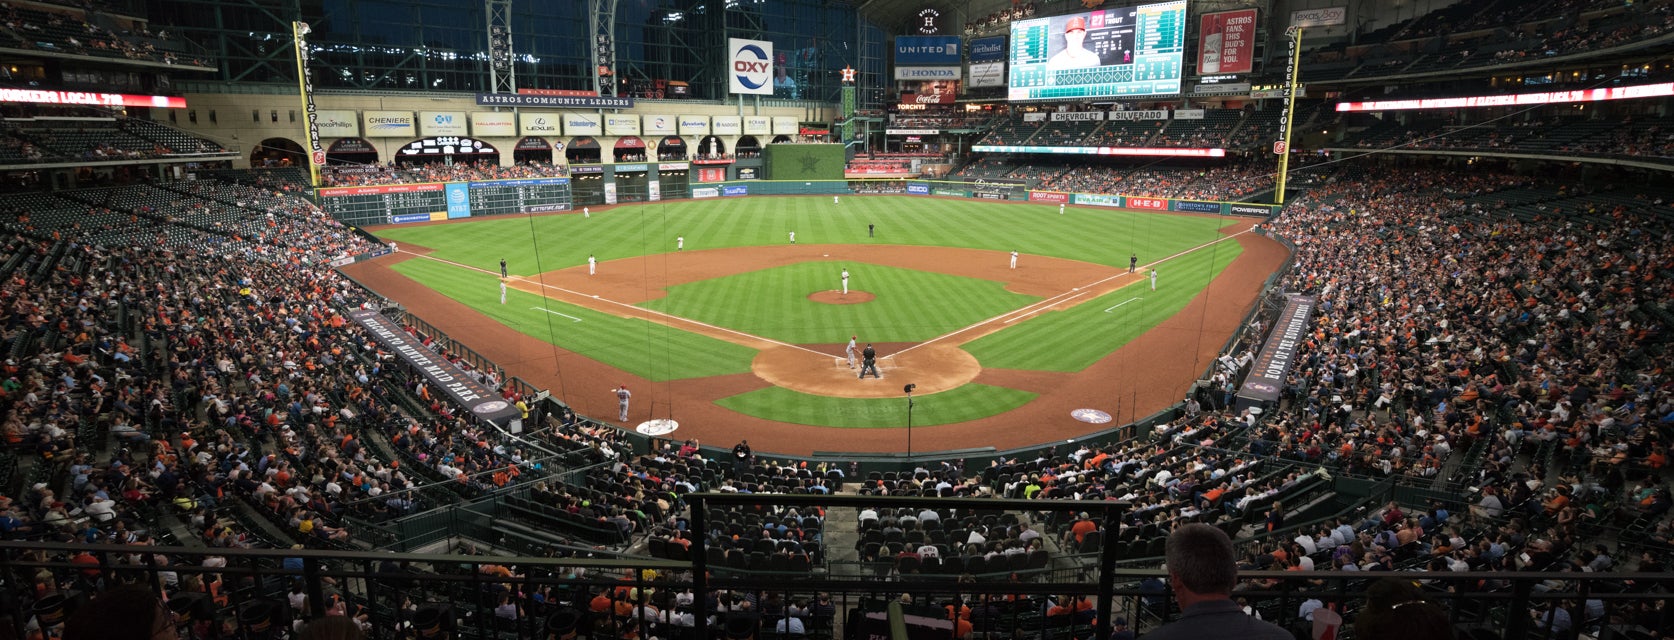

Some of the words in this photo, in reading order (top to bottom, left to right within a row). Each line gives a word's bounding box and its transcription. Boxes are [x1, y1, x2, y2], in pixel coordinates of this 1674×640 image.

[919, 9, 939, 17] HOUSTON
[1321, 9, 1342, 19] Bay
[1092, 15, 1104, 26] 27
[1227, 16, 1252, 25] ASTROS
[1226, 24, 1244, 32] FANS,
[1225, 32, 1240, 40] THIS
[900, 46, 943, 54] UNITED
[735, 60, 769, 73] OXY
[0, 88, 58, 103] ORKERS
[59, 91, 100, 104] LOCAL
[483, 95, 521, 103] ASTROS
[590, 98, 629, 106] LEADERS
[1055, 112, 1099, 120] CHEVROLET
[1115, 111, 1162, 120] SILVERADO
[1280, 109, 1288, 140] FOUL
[309, 114, 320, 150] FARE
[1278, 340, 1294, 350] THE
[1274, 350, 1289, 360] OF
[388, 337, 404, 345] TO
[397, 344, 433, 366] MINUTE
[424, 365, 454, 382] MAID
[446, 382, 480, 402] PARK
[1264, 360, 1285, 380] HOME
